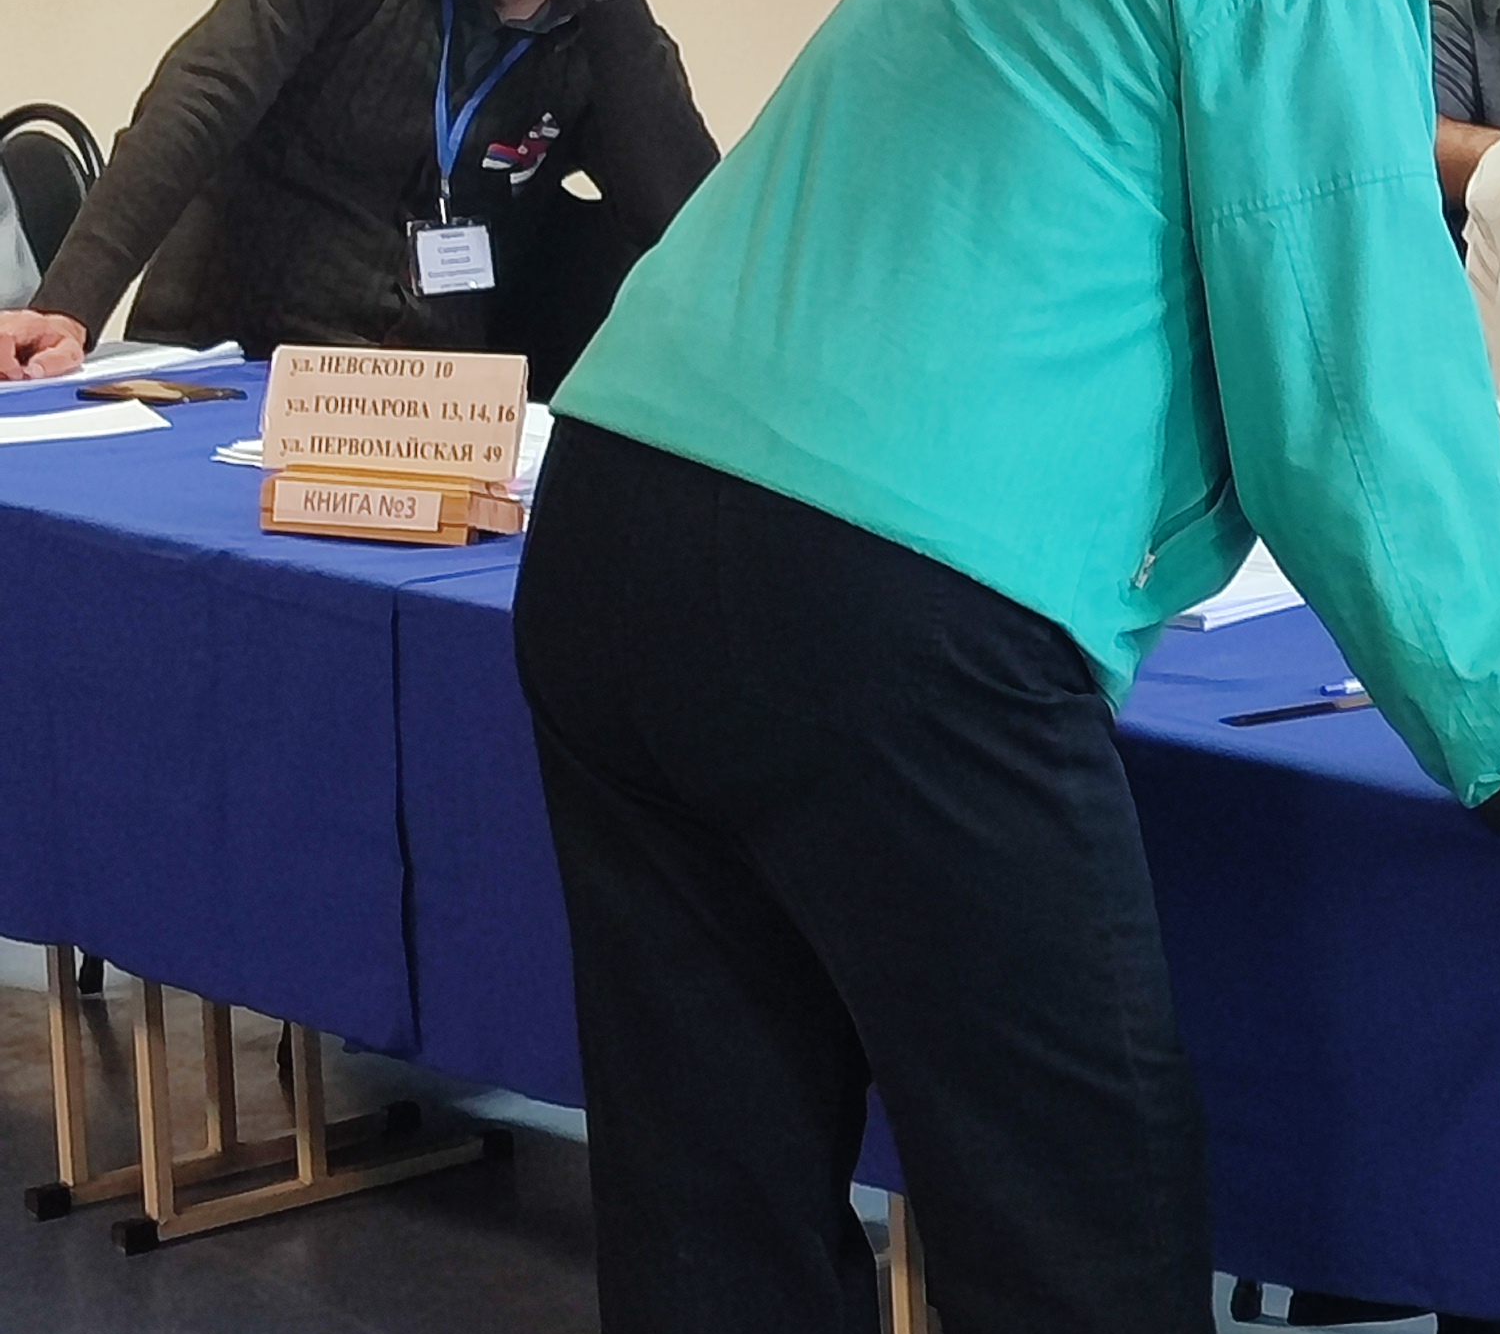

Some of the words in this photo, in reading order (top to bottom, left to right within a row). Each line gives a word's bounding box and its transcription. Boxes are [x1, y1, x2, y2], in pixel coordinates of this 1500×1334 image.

[290, 357, 313, 376] ул.
[319, 356, 425, 378] НЕВСКОГО
[435, 360, 453, 379] 10
[286, 398, 309, 416] ул.
[314, 395, 429, 419] ГОНЧАРОВА
[441, 402, 463, 421] 13,
[469, 403, 491, 423] 14,
[497, 404, 515, 423] 16
[280, 437, 304, 456] ул.
[310, 436, 473, 462] ПЕРВОМАЙСКАЯ
[484, 446, 502, 462] 49
[304, 490, 372, 516] КНИГА
[379, 496, 416, 519] №3
